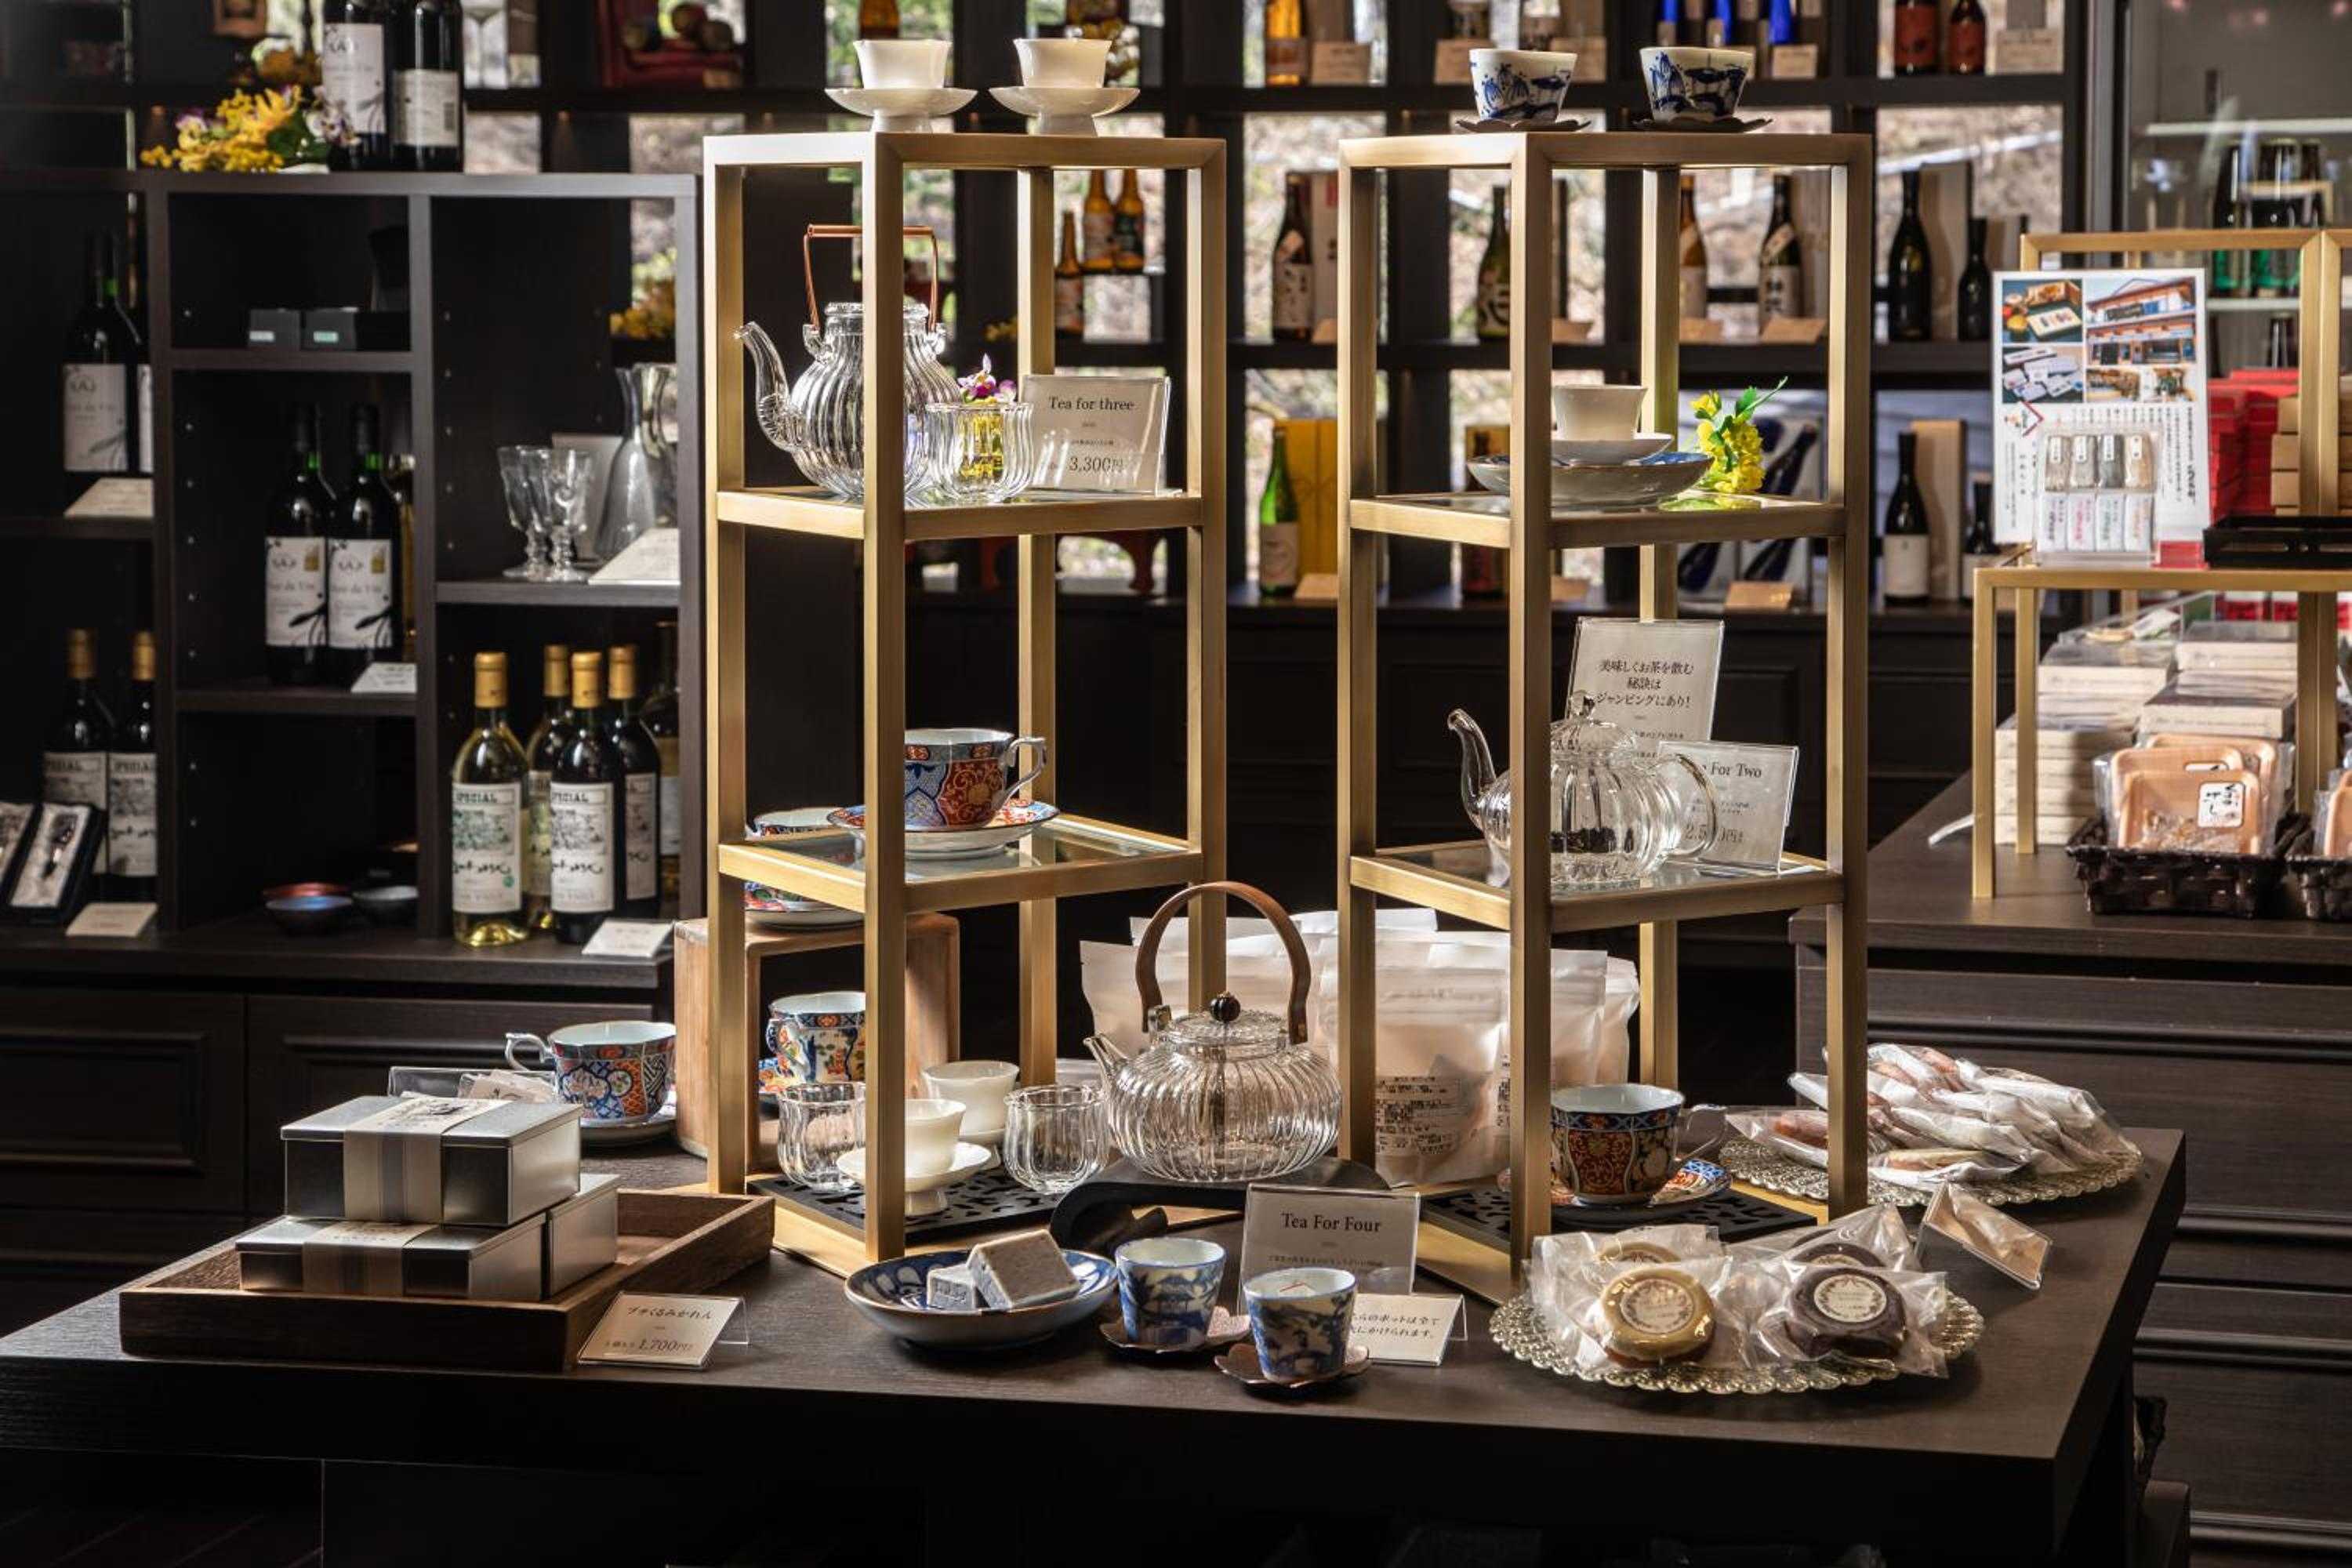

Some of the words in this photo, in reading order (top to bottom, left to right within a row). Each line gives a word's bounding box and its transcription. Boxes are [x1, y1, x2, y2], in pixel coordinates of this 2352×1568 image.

[1049, 396, 1072, 410] Tea
[1075, 396, 1096, 411] for
[1099, 397, 1134, 411] three
[1600, 659, 1693, 675] 美味しくお茶を飲む
[1627, 677, 1661, 690] 秘訣は
[1711, 762, 1732, 775] For
[1737, 763, 1762, 778] Two
[1281, 1212, 1308, 1229] Tea
[1313, 1214, 1340, 1230] For
[1345, 1215, 1381, 1232] Four
